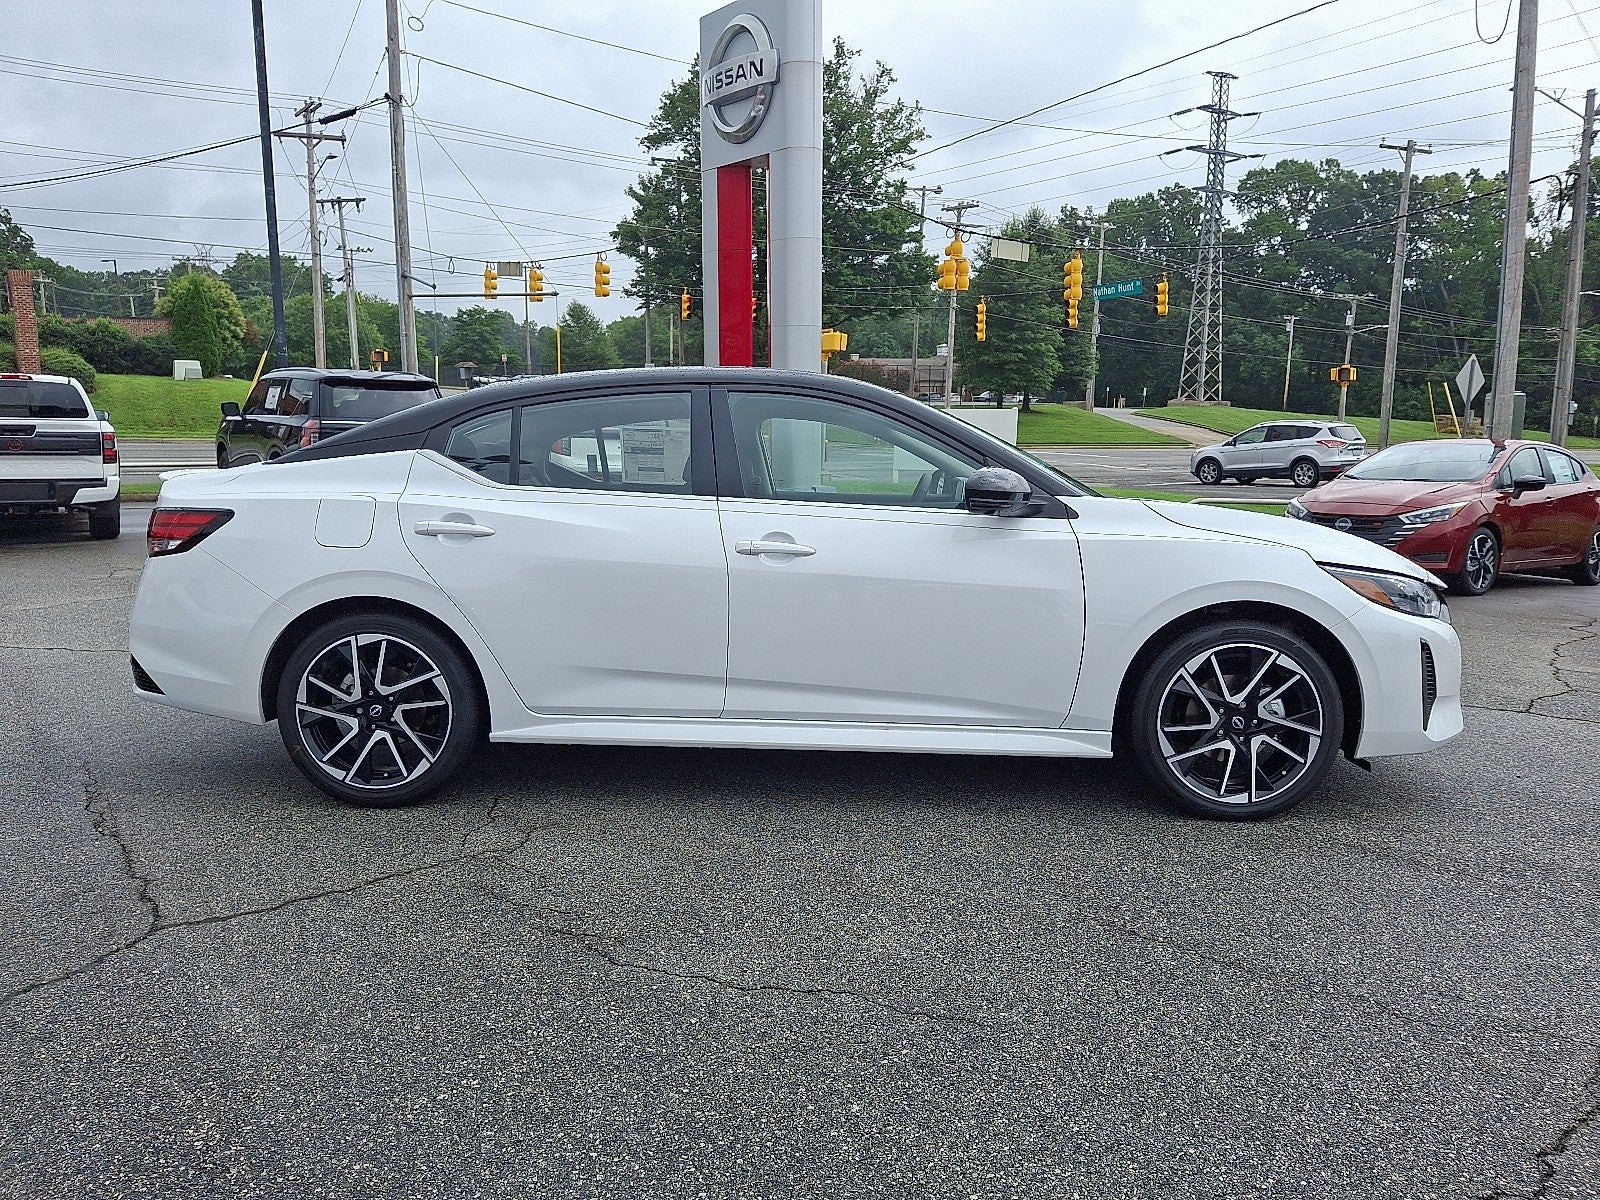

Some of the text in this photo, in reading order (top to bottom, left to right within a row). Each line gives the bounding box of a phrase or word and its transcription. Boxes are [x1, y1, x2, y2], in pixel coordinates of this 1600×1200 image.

[704, 58, 764, 95] NISSAN
[1093, 287, 1115, 296] Nathan
[1118, 282, 1134, 293] Hunt
